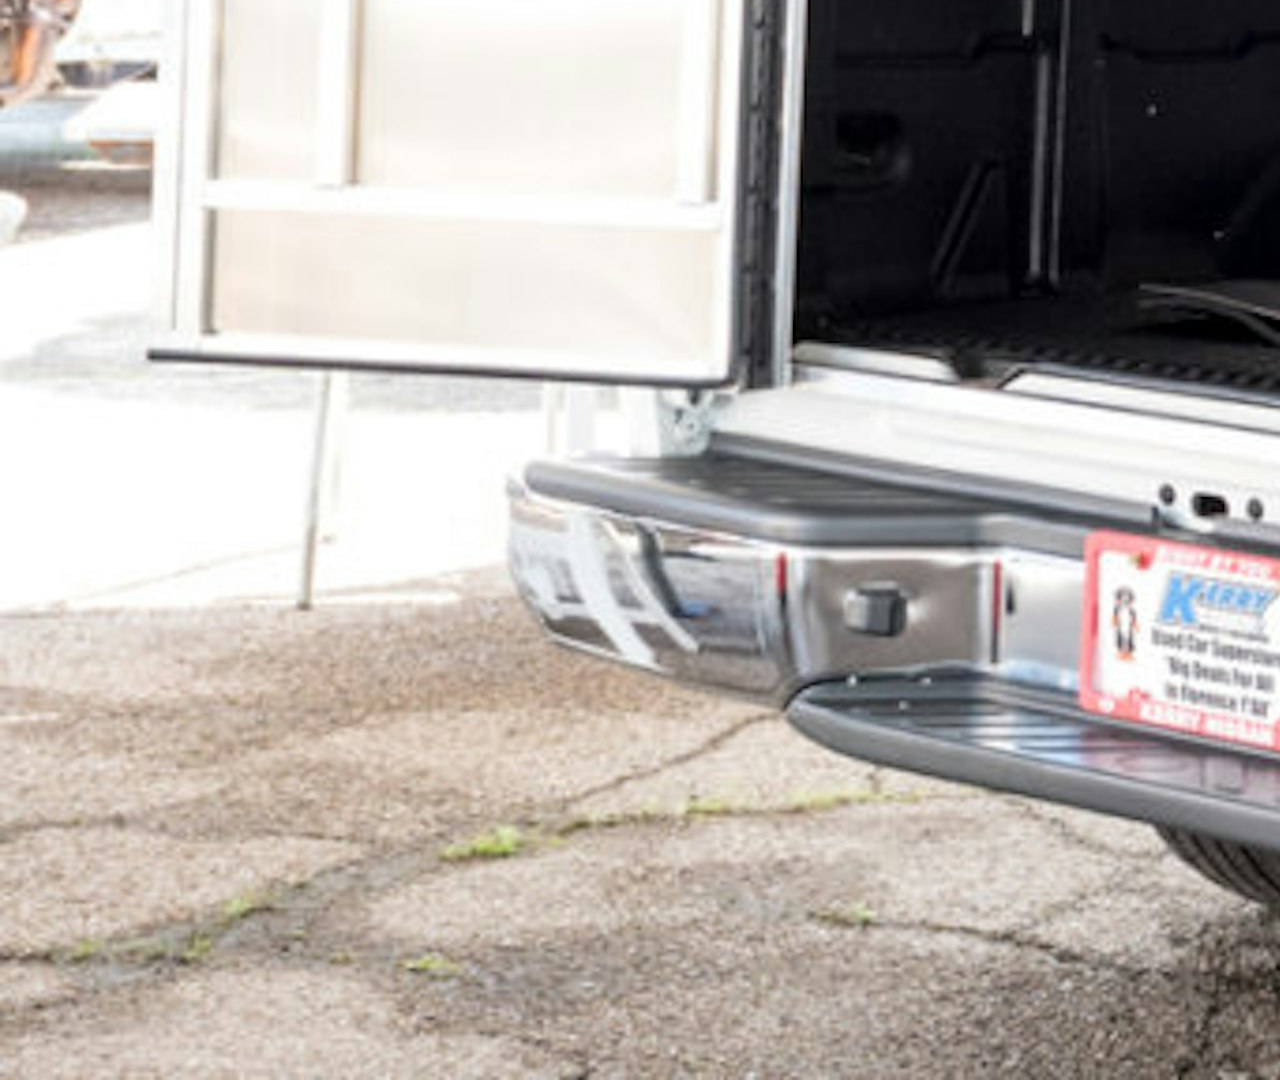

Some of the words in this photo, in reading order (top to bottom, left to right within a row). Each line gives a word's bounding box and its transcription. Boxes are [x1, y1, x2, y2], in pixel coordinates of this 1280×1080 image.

[1159, 571, 1276, 624] KERRY
[1151, 626, 1184, 651] Used
[1187, 633, 1208, 654] Car
